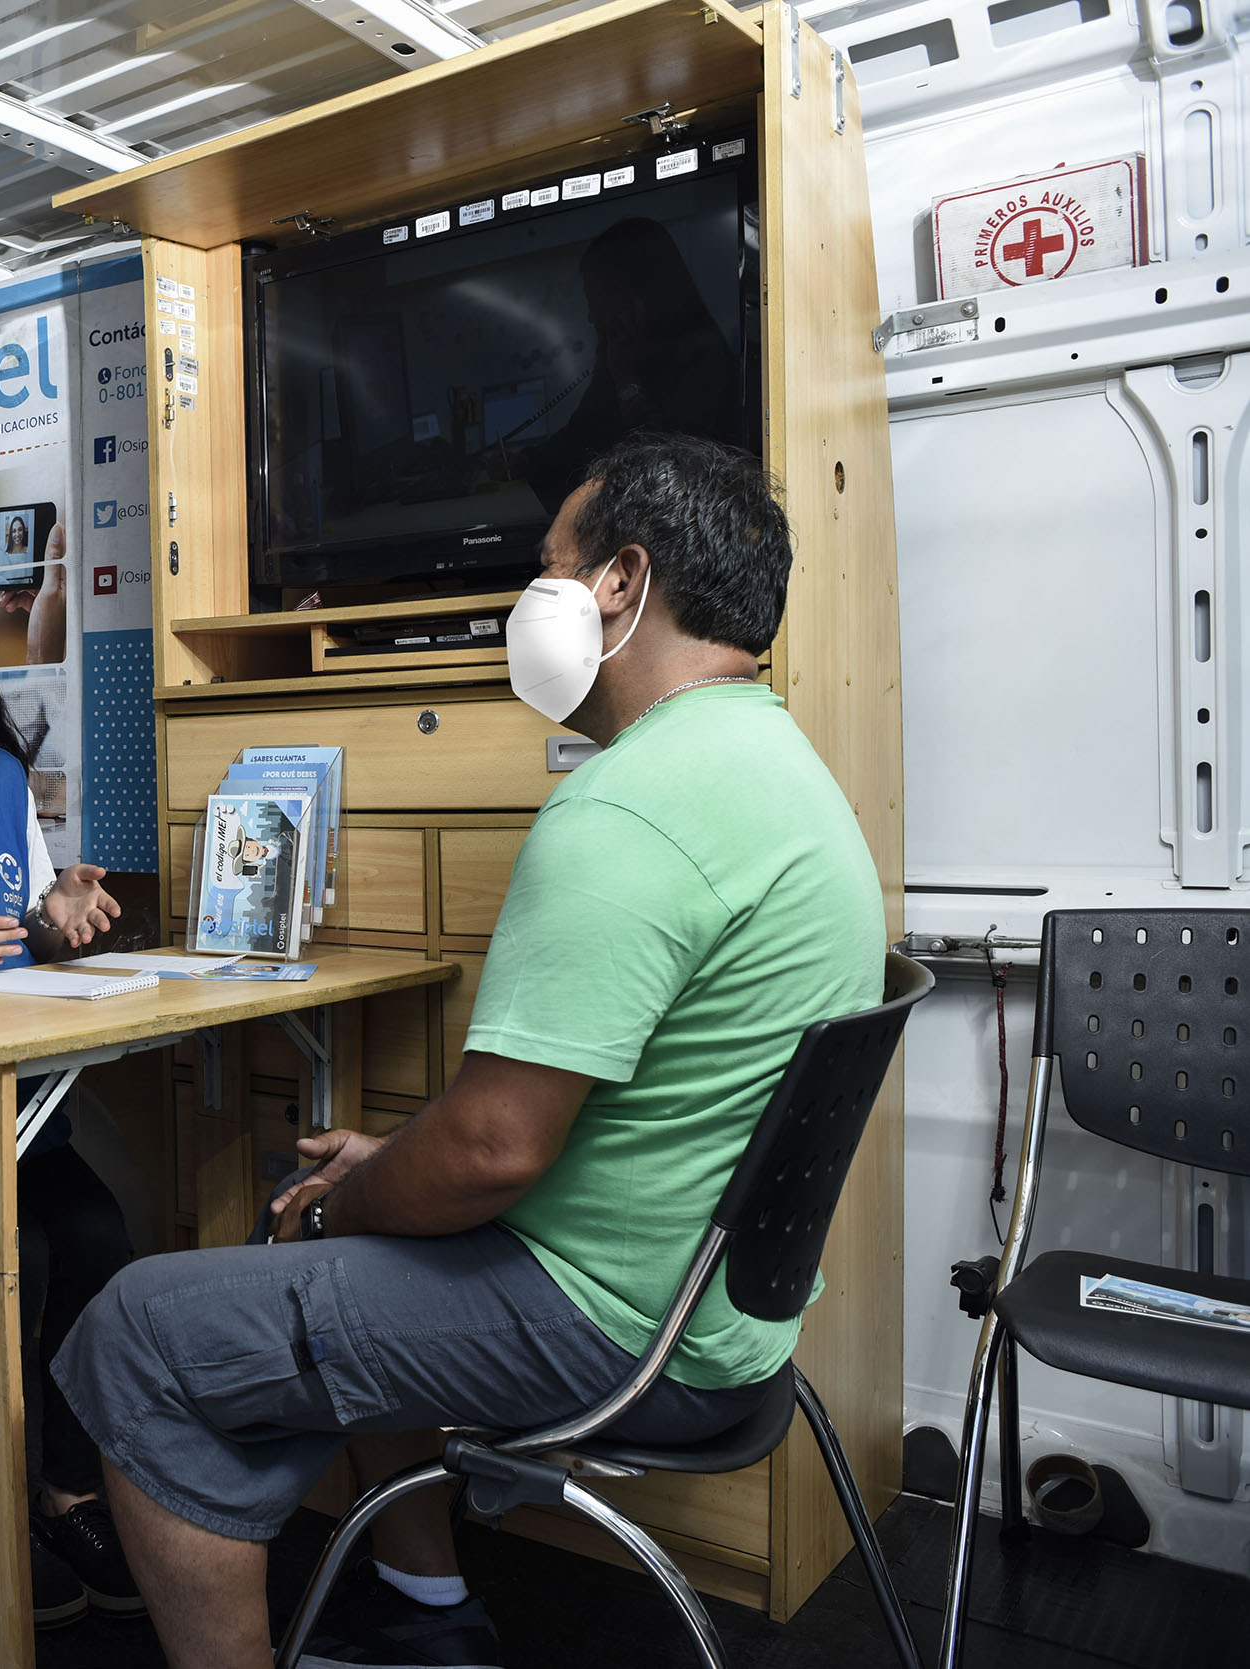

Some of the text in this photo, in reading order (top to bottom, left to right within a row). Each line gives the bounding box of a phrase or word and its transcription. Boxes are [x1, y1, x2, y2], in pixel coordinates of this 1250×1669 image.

[975, 191, 1095, 268] PRIMEROS AUXILIOS
[117, 503, 150, 520] @OSI
[463, 534, 502, 545] Panasonic
[250, 754, 306, 763] ¿SABES CUÁNTAS
[262, 769, 317, 779] ¿POR QUÉ DEBES
[278, 913, 287, 940] osiptel
